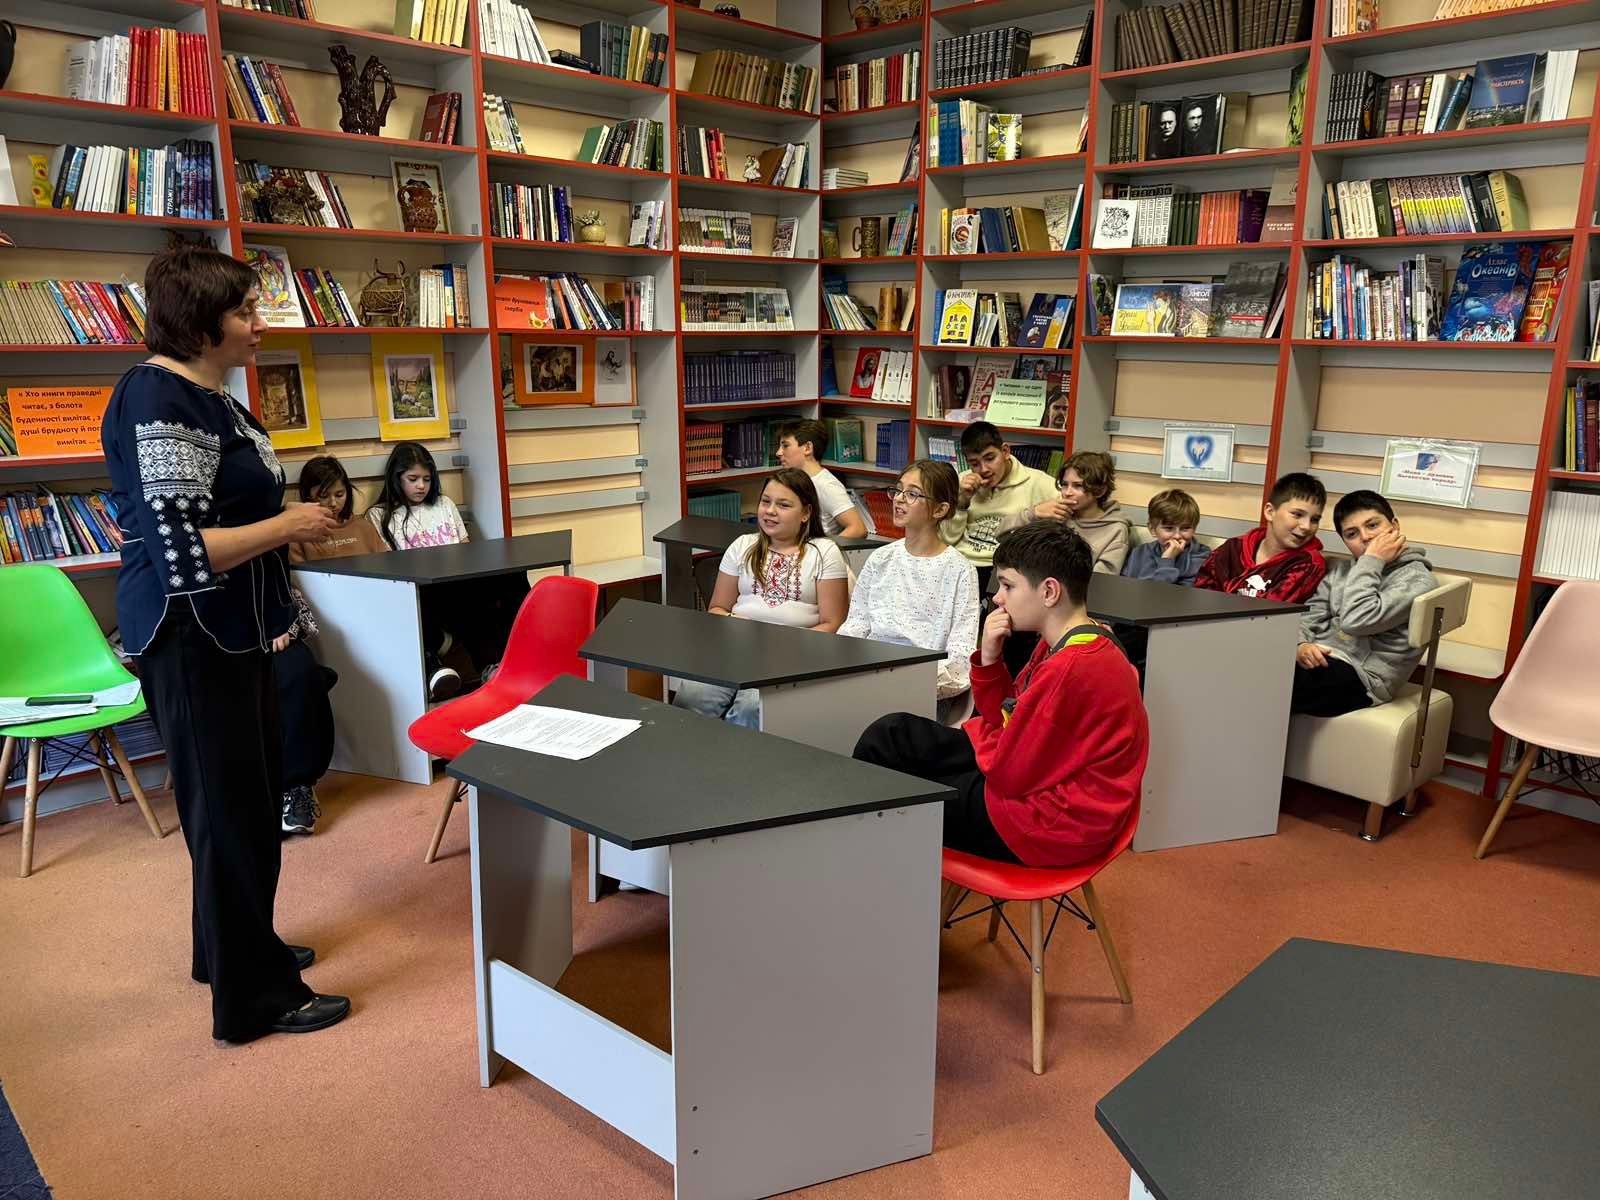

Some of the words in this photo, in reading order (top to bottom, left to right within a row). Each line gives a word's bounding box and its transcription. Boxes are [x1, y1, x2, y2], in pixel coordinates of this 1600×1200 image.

[66, 389, 102, 398] праведні
[55, 401, 83, 410] болота
[15, 415, 61, 424] буденності
[20, 427, 40, 436] душі
[41, 425, 79, 436] брудноту
[56, 438, 87, 446] вимітає
